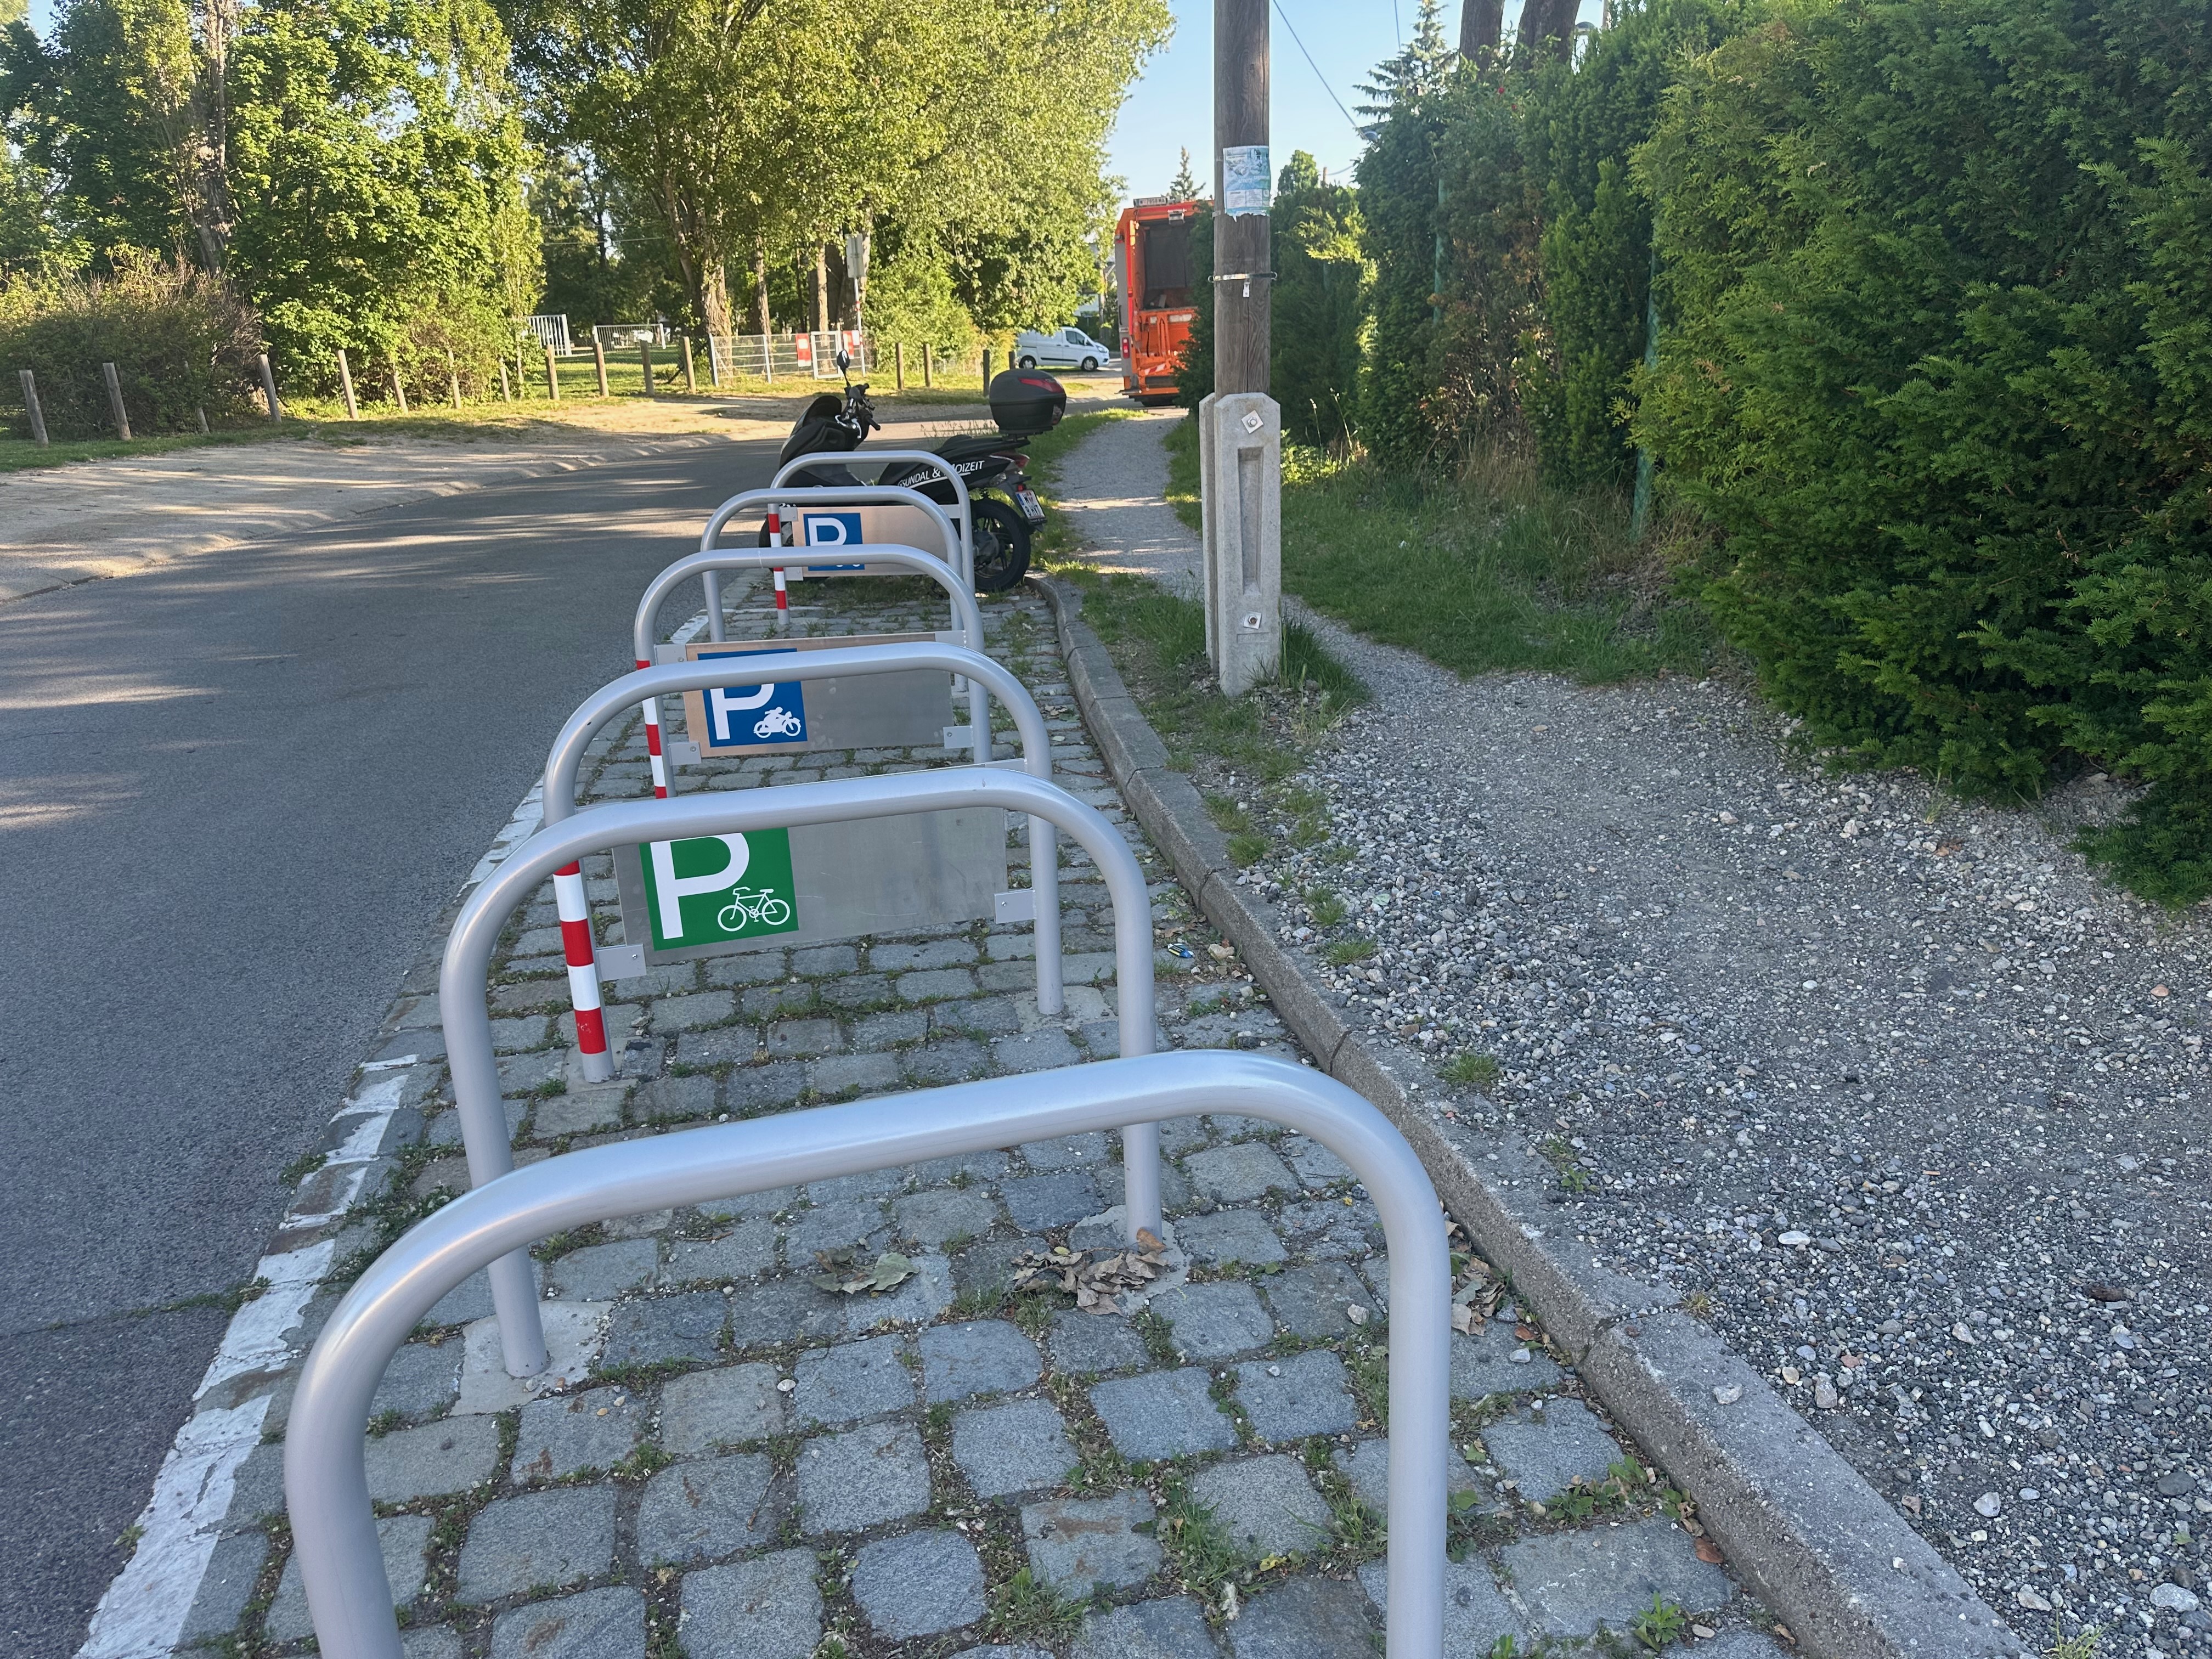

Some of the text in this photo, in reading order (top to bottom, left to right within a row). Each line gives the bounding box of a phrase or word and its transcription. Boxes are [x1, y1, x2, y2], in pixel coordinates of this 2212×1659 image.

[932, 467, 941, 478] &
[710, 683, 775, 740] P
[650, 832, 750, 939] P
